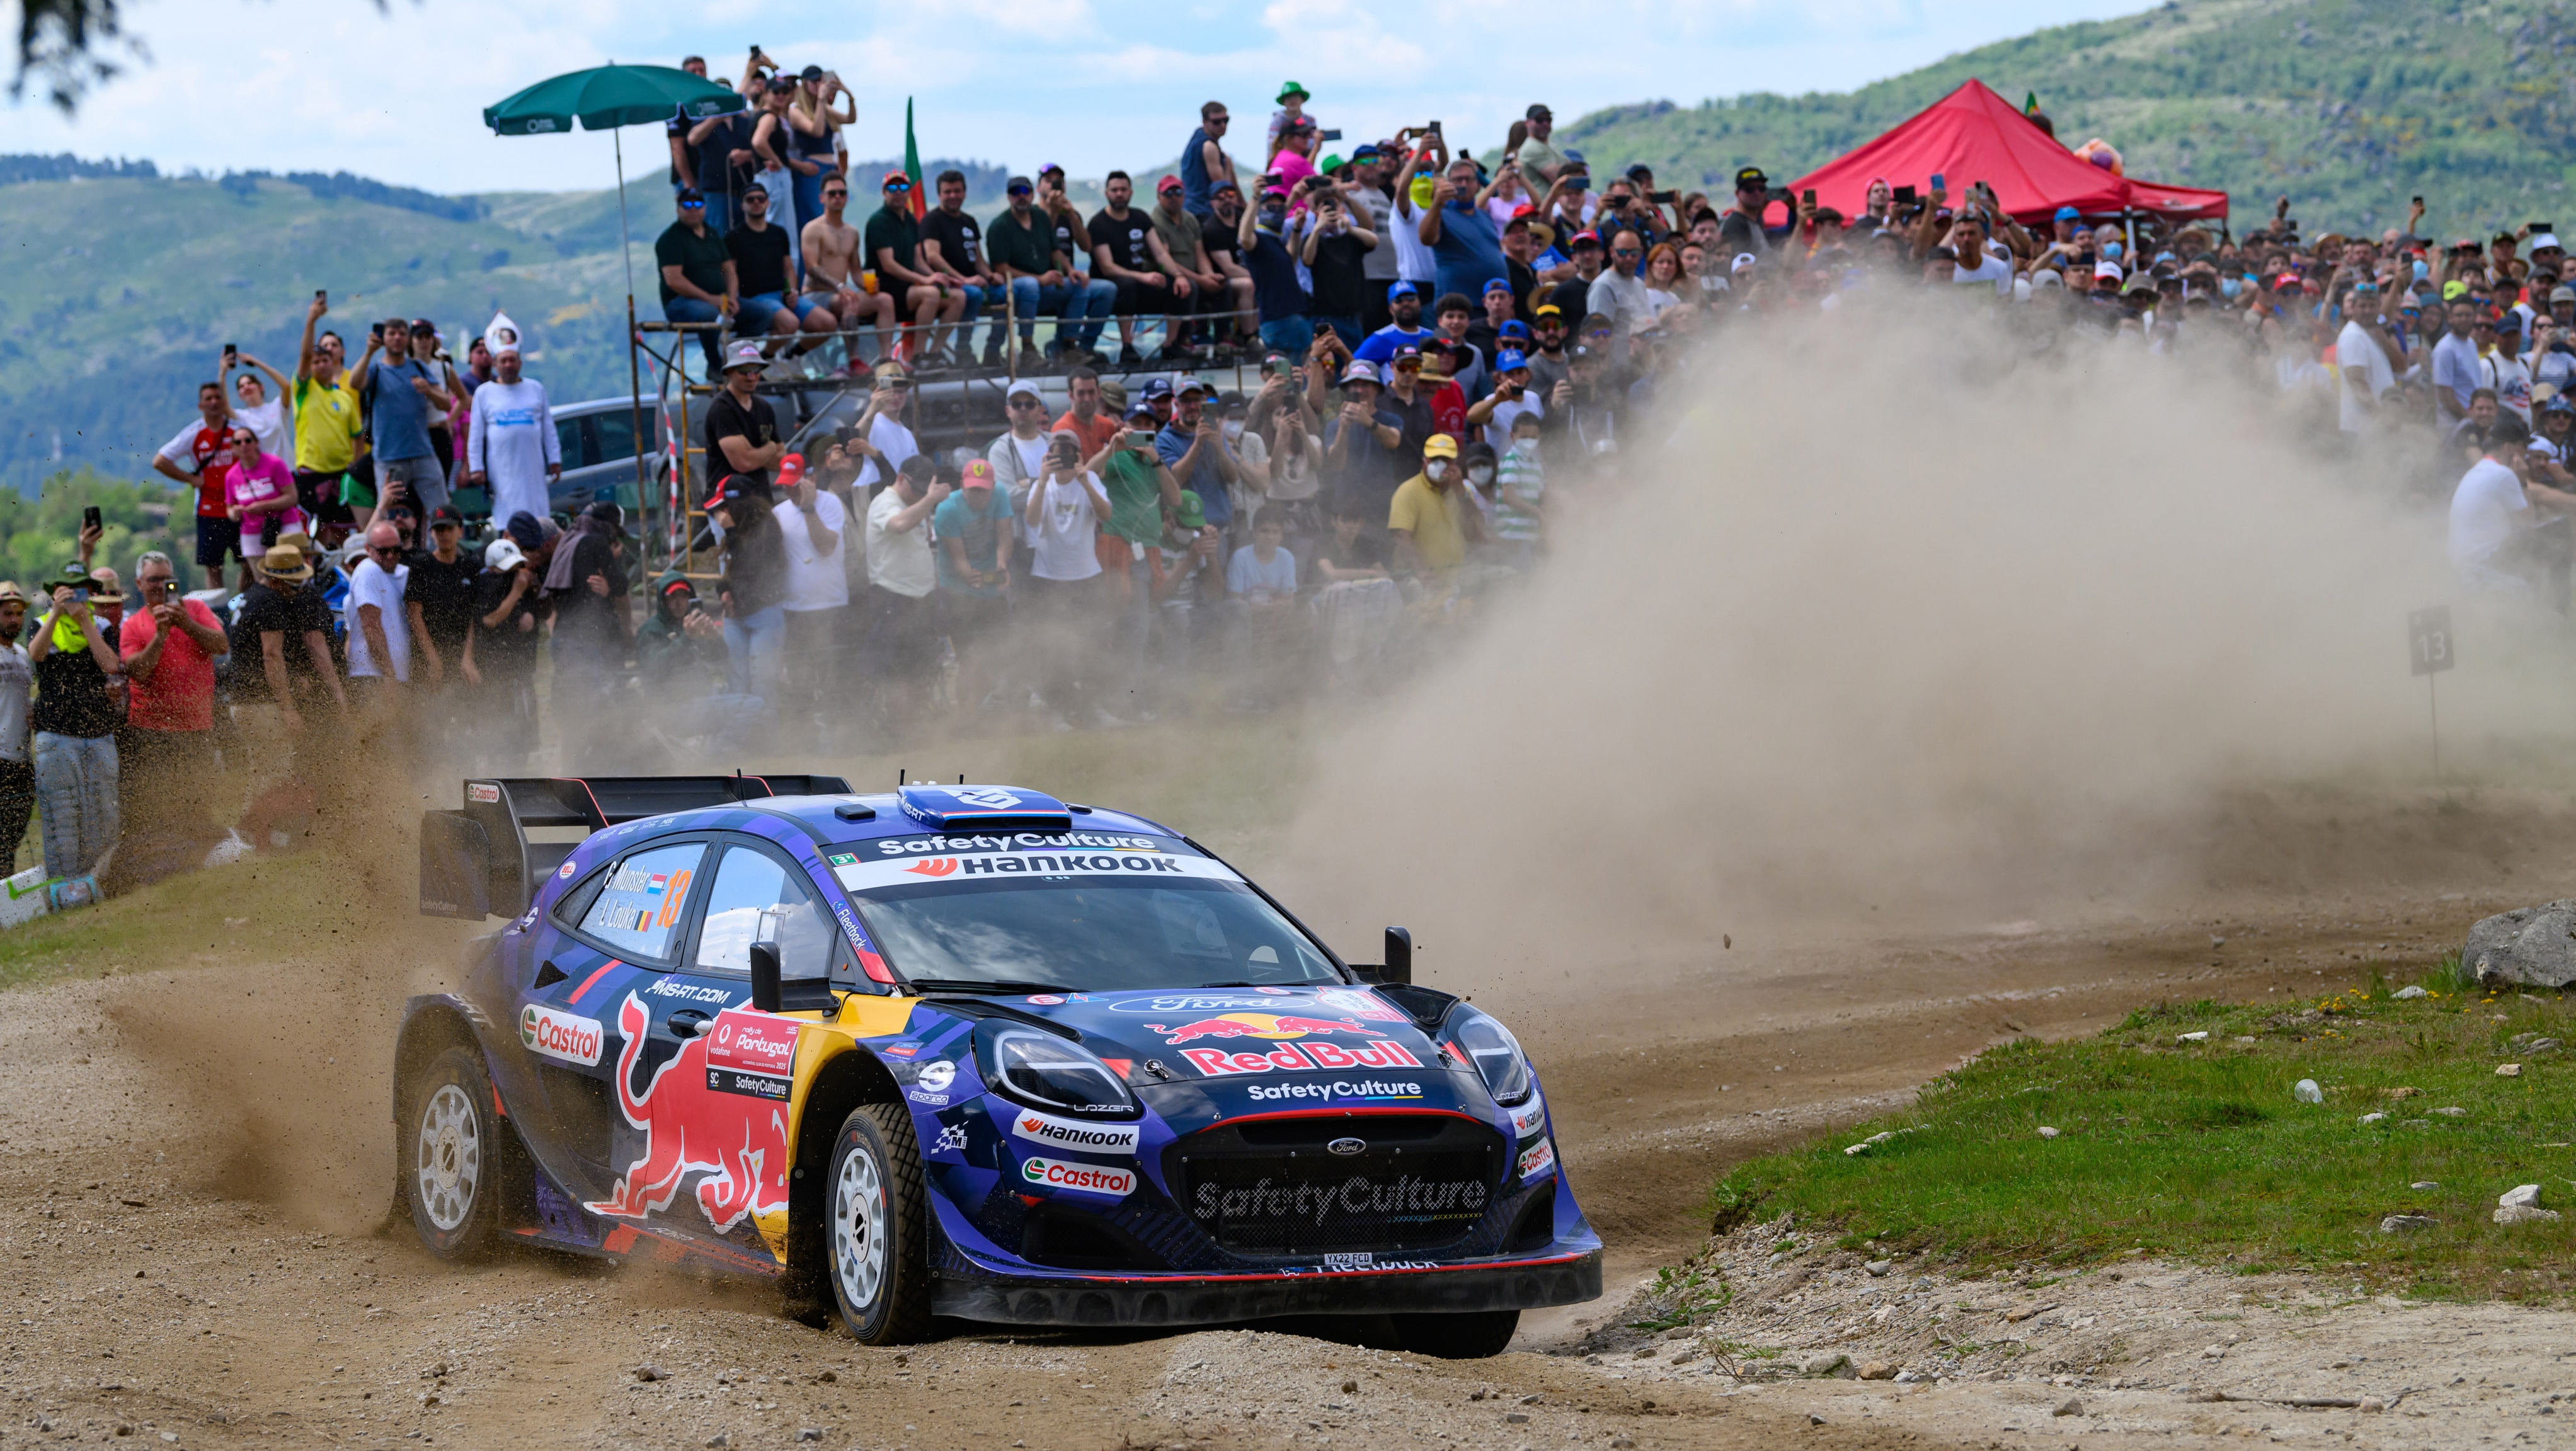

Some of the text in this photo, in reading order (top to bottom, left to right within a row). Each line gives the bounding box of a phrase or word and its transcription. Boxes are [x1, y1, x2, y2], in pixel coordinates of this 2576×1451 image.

[2418, 631, 2447, 662] 13
[474, 786, 497, 800] Castrol
[878, 832, 1155, 854] SafetyCulture
[561, 865, 572, 874] BELL
[604, 861, 651, 893] G Munster
[421, 900, 457, 912] SafetyCulture
[656, 869, 692, 929] 13
[598, 898, 636, 930] L Louka
[837, 908, 867, 951] Fleetback
[1151, 995, 1281, 1011] Ford
[537, 1016, 600, 1060] Castrol
[741, 1027, 755, 1035] rally
[710, 1047, 731, 1057] vodafone
[736, 1034, 791, 1057] Portugal
[776, 1062, 786, 1070] 2025
[710, 1072, 719, 1084] SC
[736, 1075, 786, 1095] SafetyCulture
[911, 1092, 948, 1103] sparco
[1247, 1080, 1422, 1102] SafetyCulture
[1073, 1104, 1134, 1112] LAZER
[1336, 1139, 1359, 1152] Ford
[1526, 1140, 1553, 1171] Castrol
[1048, 1164, 1130, 1192] Castrol
[1194, 1174, 1486, 1227] SafetyCulture
[1327, 1253, 1369, 1263] YX22 FCD
